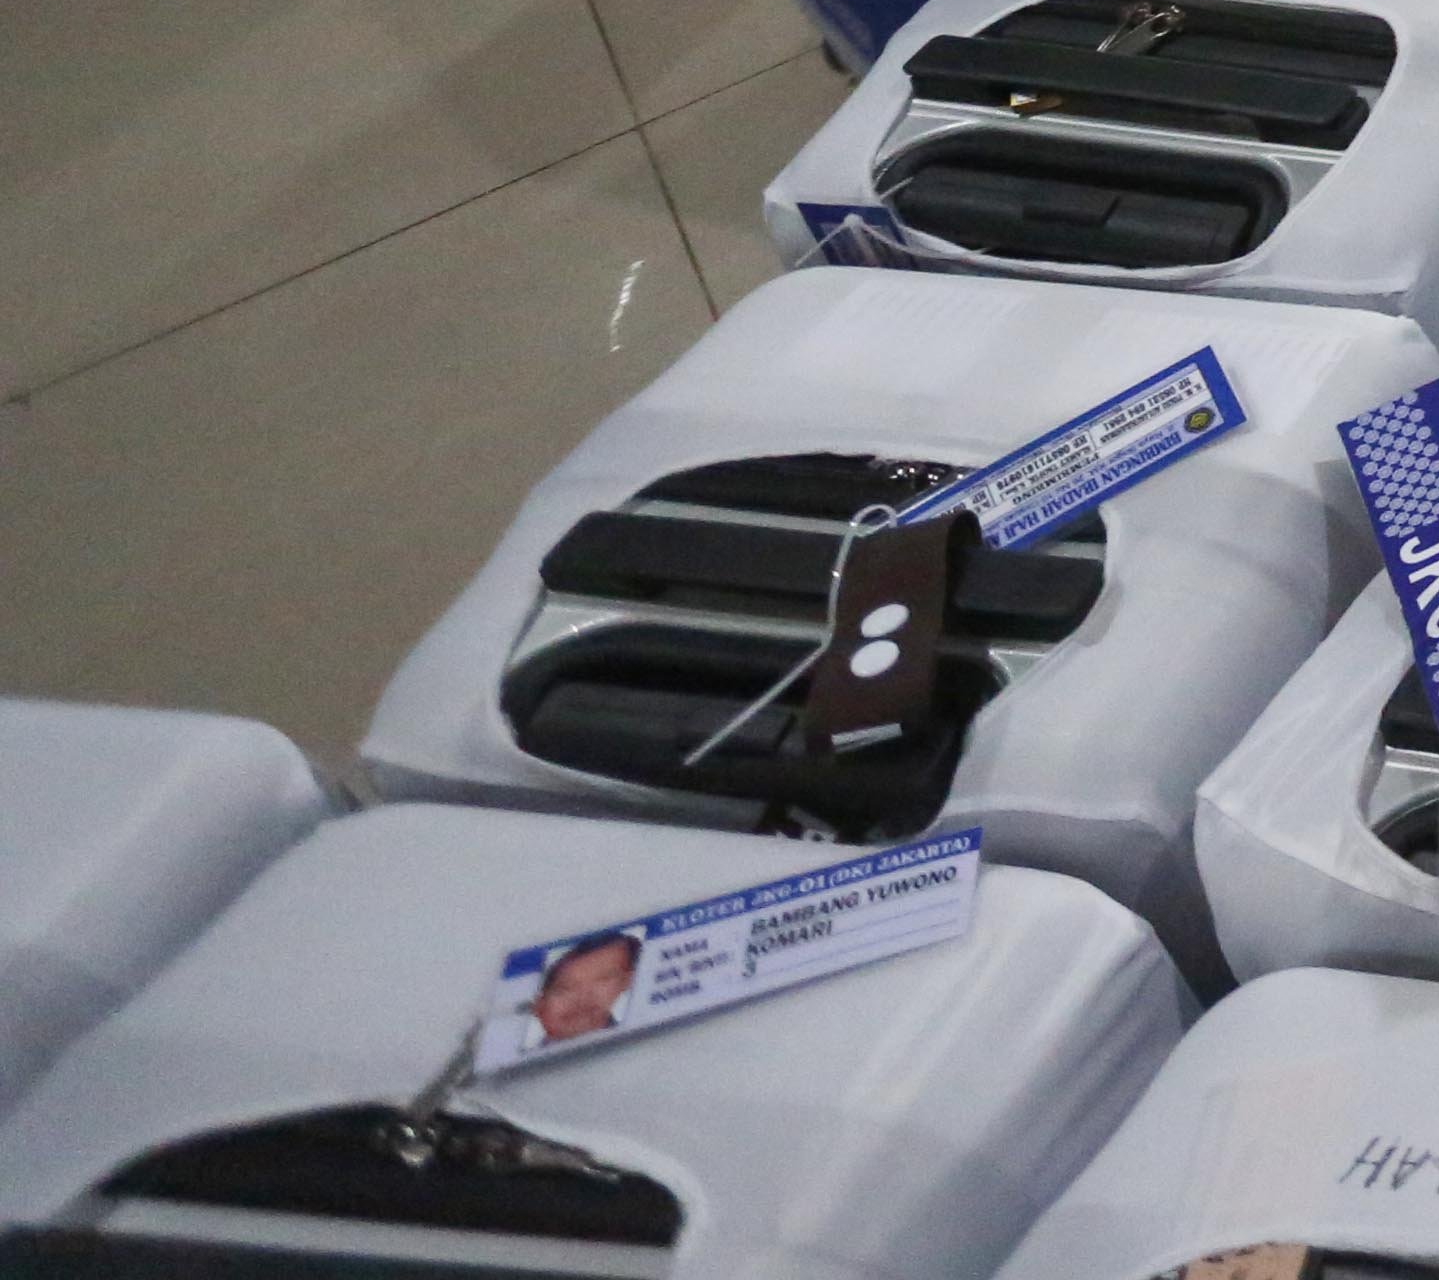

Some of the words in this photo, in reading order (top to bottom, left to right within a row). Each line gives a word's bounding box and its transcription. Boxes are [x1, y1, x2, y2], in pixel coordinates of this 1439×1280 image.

[876, 835, 970, 873] JAKARTA)
[750, 891, 859, 935] BAMBANG
[865, 864, 956, 903] YUWONO
[747, 919, 832, 958] KOMARI
